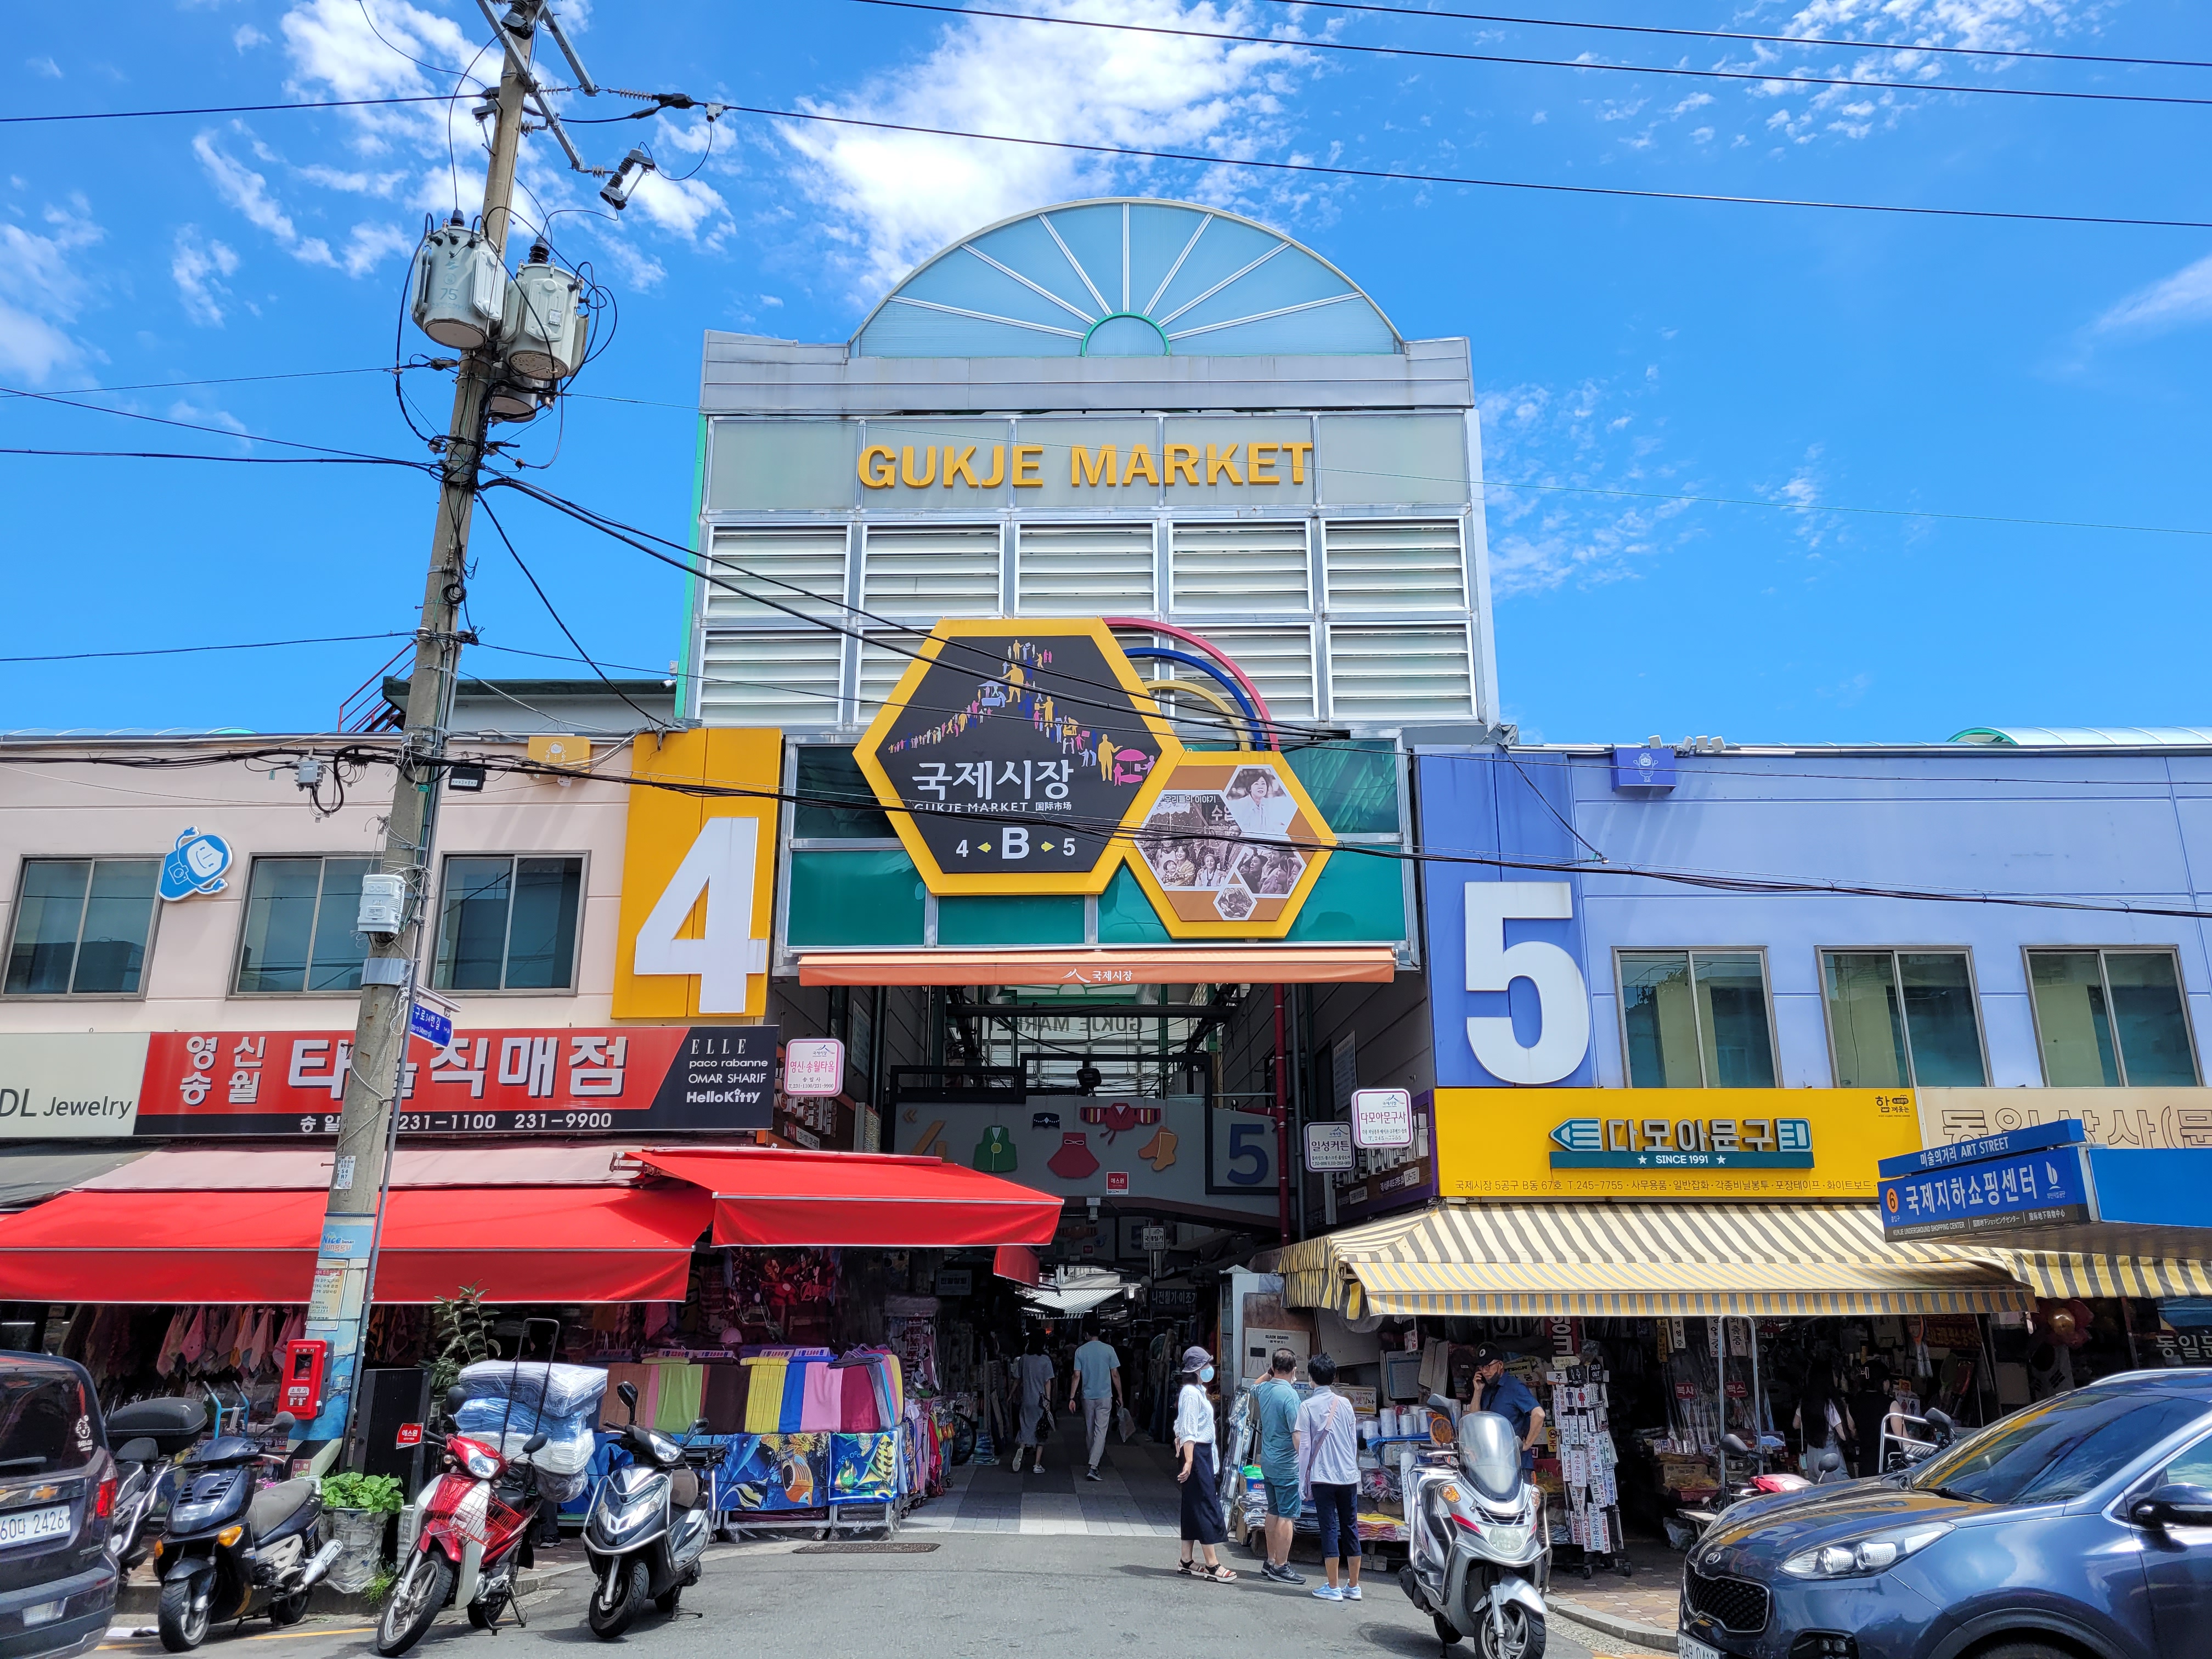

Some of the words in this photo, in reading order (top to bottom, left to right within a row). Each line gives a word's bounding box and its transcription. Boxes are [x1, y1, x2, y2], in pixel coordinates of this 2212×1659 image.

[440, 288, 459, 300] 75
[857, 444, 1043, 488] GUKJE
[1071, 442, 1313, 487] MARKET
[912, 760, 1074, 800] 국제시장
[1035, 802, 1072, 811] 国际市场
[1164, 795, 1193, 803] 우리들의
[1195, 795, 1216, 803] 이야기
[914, 803, 961, 812] GUKJE
[968, 802, 1028, 812] MARKET
[956, 839, 969, 857] 4
[1002, 827, 1029, 859] B
[1063, 838, 1075, 856] 5
[634, 816, 767, 1013] 4
[1092, 969, 1133, 983] 국제시장
[1464, 881, 1590, 1084] 5
[413, 1005, 441, 1031] 구로34번길
[691, 1039, 747, 1054] ELLE
[689, 1060, 718, 1069] paco
[721, 1059, 768, 1067] rabanne
[790, 1060, 835, 1073] 영신·송월타올
[689, 1074, 723, 1084] OMAR
[727, 1073, 767, 1083] SHARIF
[43, 1096, 133, 1120] Jewelry
[398, 1114, 496, 1130] 231-1100
[514, 1113, 612, 1129] 231-9900
[1361, 1111, 1406, 1124] 다모아문구사
[1605, 1119, 1774, 1152] 다모아문구
[1311, 1140, 1350, 1152] 일성커튼
[1920, 1146, 1957, 1167] 미술의거리
[1960, 1143, 1977, 1158] ART
[1979, 1136, 2009, 1154] STREET
[1227, 1124, 1269, 1185] 5
[1656, 1155, 1687, 1164] SINCE
[1689, 1155, 1708, 1164] 1991
[1455, 1180, 1492, 1191] 국제시장
[1495, 1180, 1519, 1191] 5공구
[1522, 1180, 1538, 1191] B동
[1541, 1180, 1563, 1190] 67호
[1567, 1180, 1623, 1190] T.245-7755
[1905, 1164, 2038, 1216] 국제지하쇼핑센터
[1889, 1192, 1896, 1210] 6
[1931, 1223, 1949, 1232] SHOPPING
[1949, 1221, 1966, 1229] CENTER
[322, 1235, 342, 1244] Nice
[33, 1510, 64, 1534] 2426
